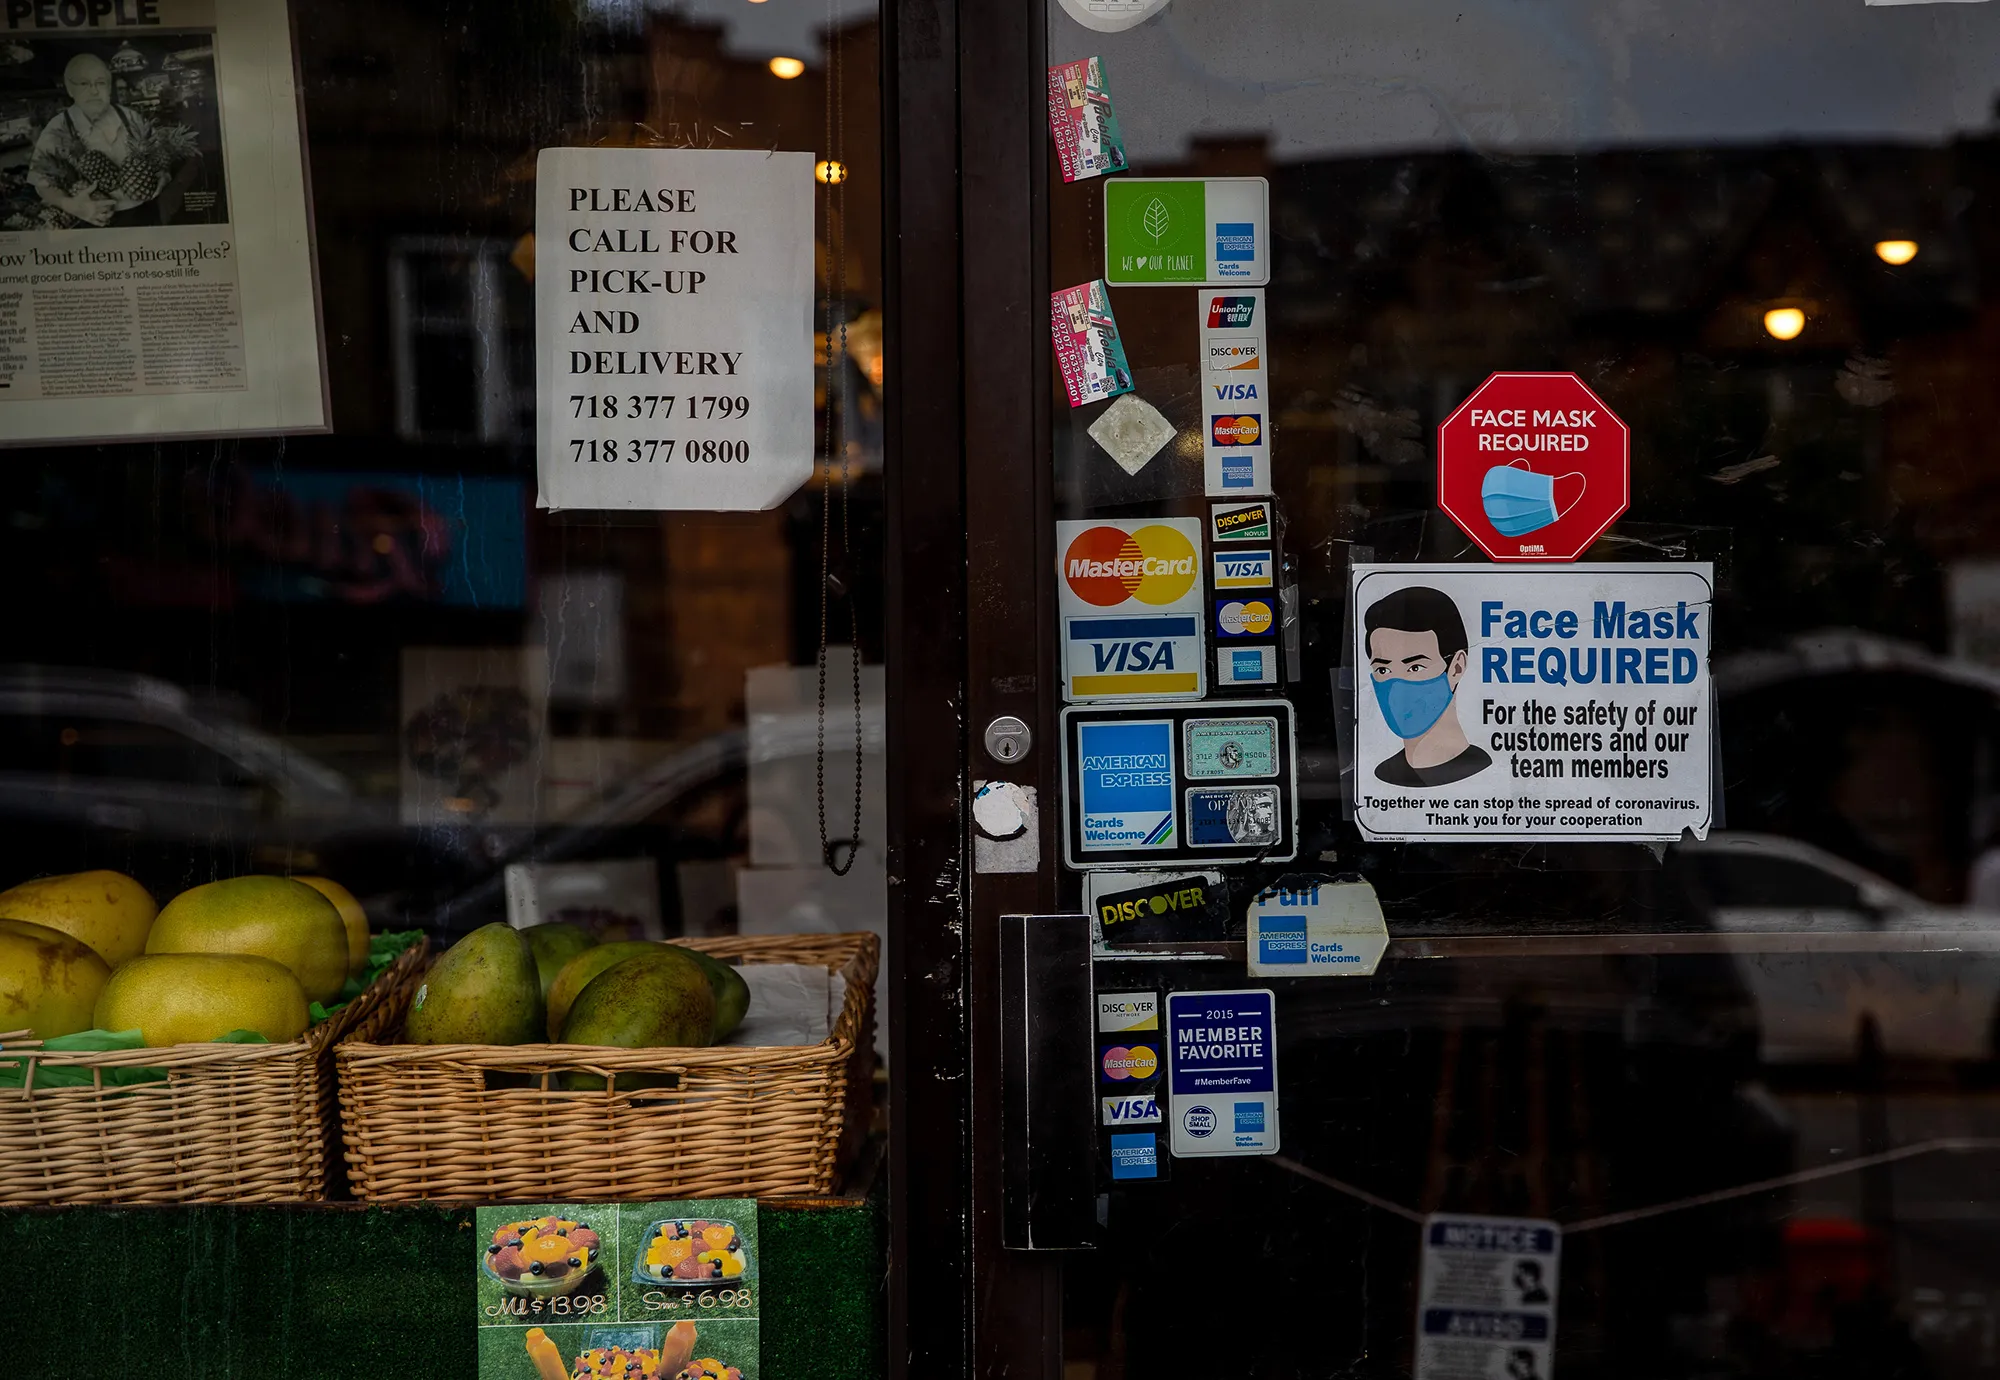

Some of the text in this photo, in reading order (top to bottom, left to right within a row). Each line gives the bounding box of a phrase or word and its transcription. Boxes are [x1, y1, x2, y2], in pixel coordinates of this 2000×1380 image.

[7, 0, 160, 29] PEOPLE
[1088, 98, 1112, 146] Puebla
[1091, 128, 1100, 144] City
[568, 187, 697, 213] PLEASE
[568, 228, 739, 254] CALL FOR
[79, 246, 124, 264] them
[128, 240, 231, 268] pineapples?
[1122, 254, 1194, 271] WE OUR PLANET
[31, 274, 61, 285] grocer
[64, 271, 96, 282] Daniel
[133, 267, 183, 279] not-so-still
[184, 267, 200, 277] life
[568, 269, 706, 294] PICK-UP
[1211, 304, 1253, 316] UnionPay
[568, 310, 640, 334] AND
[1092, 322, 1116, 369] Puebla
[1211, 347, 1256, 356] DISCOVER
[568, 351, 743, 375] DELIVERY
[1095, 352, 1105, 367] City
[1213, 384, 1258, 400] VISA
[569, 395, 750, 419] 718 377 1799
[1470, 409, 1597, 428] FACE MASK
[1214, 426, 1259, 435] MasterCard
[569, 439, 750, 463] 718 377 0800
[1478, 434, 1589, 452] REQUIRED
[1217, 509, 1264, 528] DISCOVER
[1520, 545, 1544, 553] OptiMA
[1224, 562, 1263, 577] VISA
[1220, 612, 1270, 624] MasterCard
[1481, 601, 1699, 639] Face Mask
[1090, 641, 1175, 673] VISA
[1482, 647, 1698, 687] REQUIRED
[1482, 699, 1698, 732] For the safety of our
[1491, 727, 1689, 752] customers and our
[1083, 753, 1167, 771] AMERICAN
[1511, 753, 1669, 779] team members
[1100, 772, 1172, 788] EXPRESS
[1364, 796, 1700, 811] Together we can stop the spread of coronavirus.
[1085, 817, 1124, 829] Cards
[1425, 813, 1643, 829] Thank you for your cooperation
[1085, 830, 1146, 841] Welcome
[1101, 887, 1206, 926] DISCOVER
[1260, 932, 1305, 941] AMERICAN
[1268, 941, 1307, 950] EXPRESS
[1311, 943, 1343, 952] Cards
[1311, 953, 1361, 963] Welcome
[1102, 1002, 1153, 1013] DISCOVER
[1206, 1010, 1234, 1020] 2015
[1178, 1026, 1263, 1043] MEMBER
[1179, 1043, 1264, 1060] FAVORITE
[1104, 1057, 1156, 1069] MasterCard
[1194, 1077, 1252, 1087] #MemberFave
[1108, 1100, 1159, 1120] VISA
[1112, 1147, 1154, 1157] AMERICAN
[1120, 1157, 1157, 1166] EXPRESS
[1443, 1225, 1539, 1249] NOTICE
[642, 1291, 680, 1311] Sm
